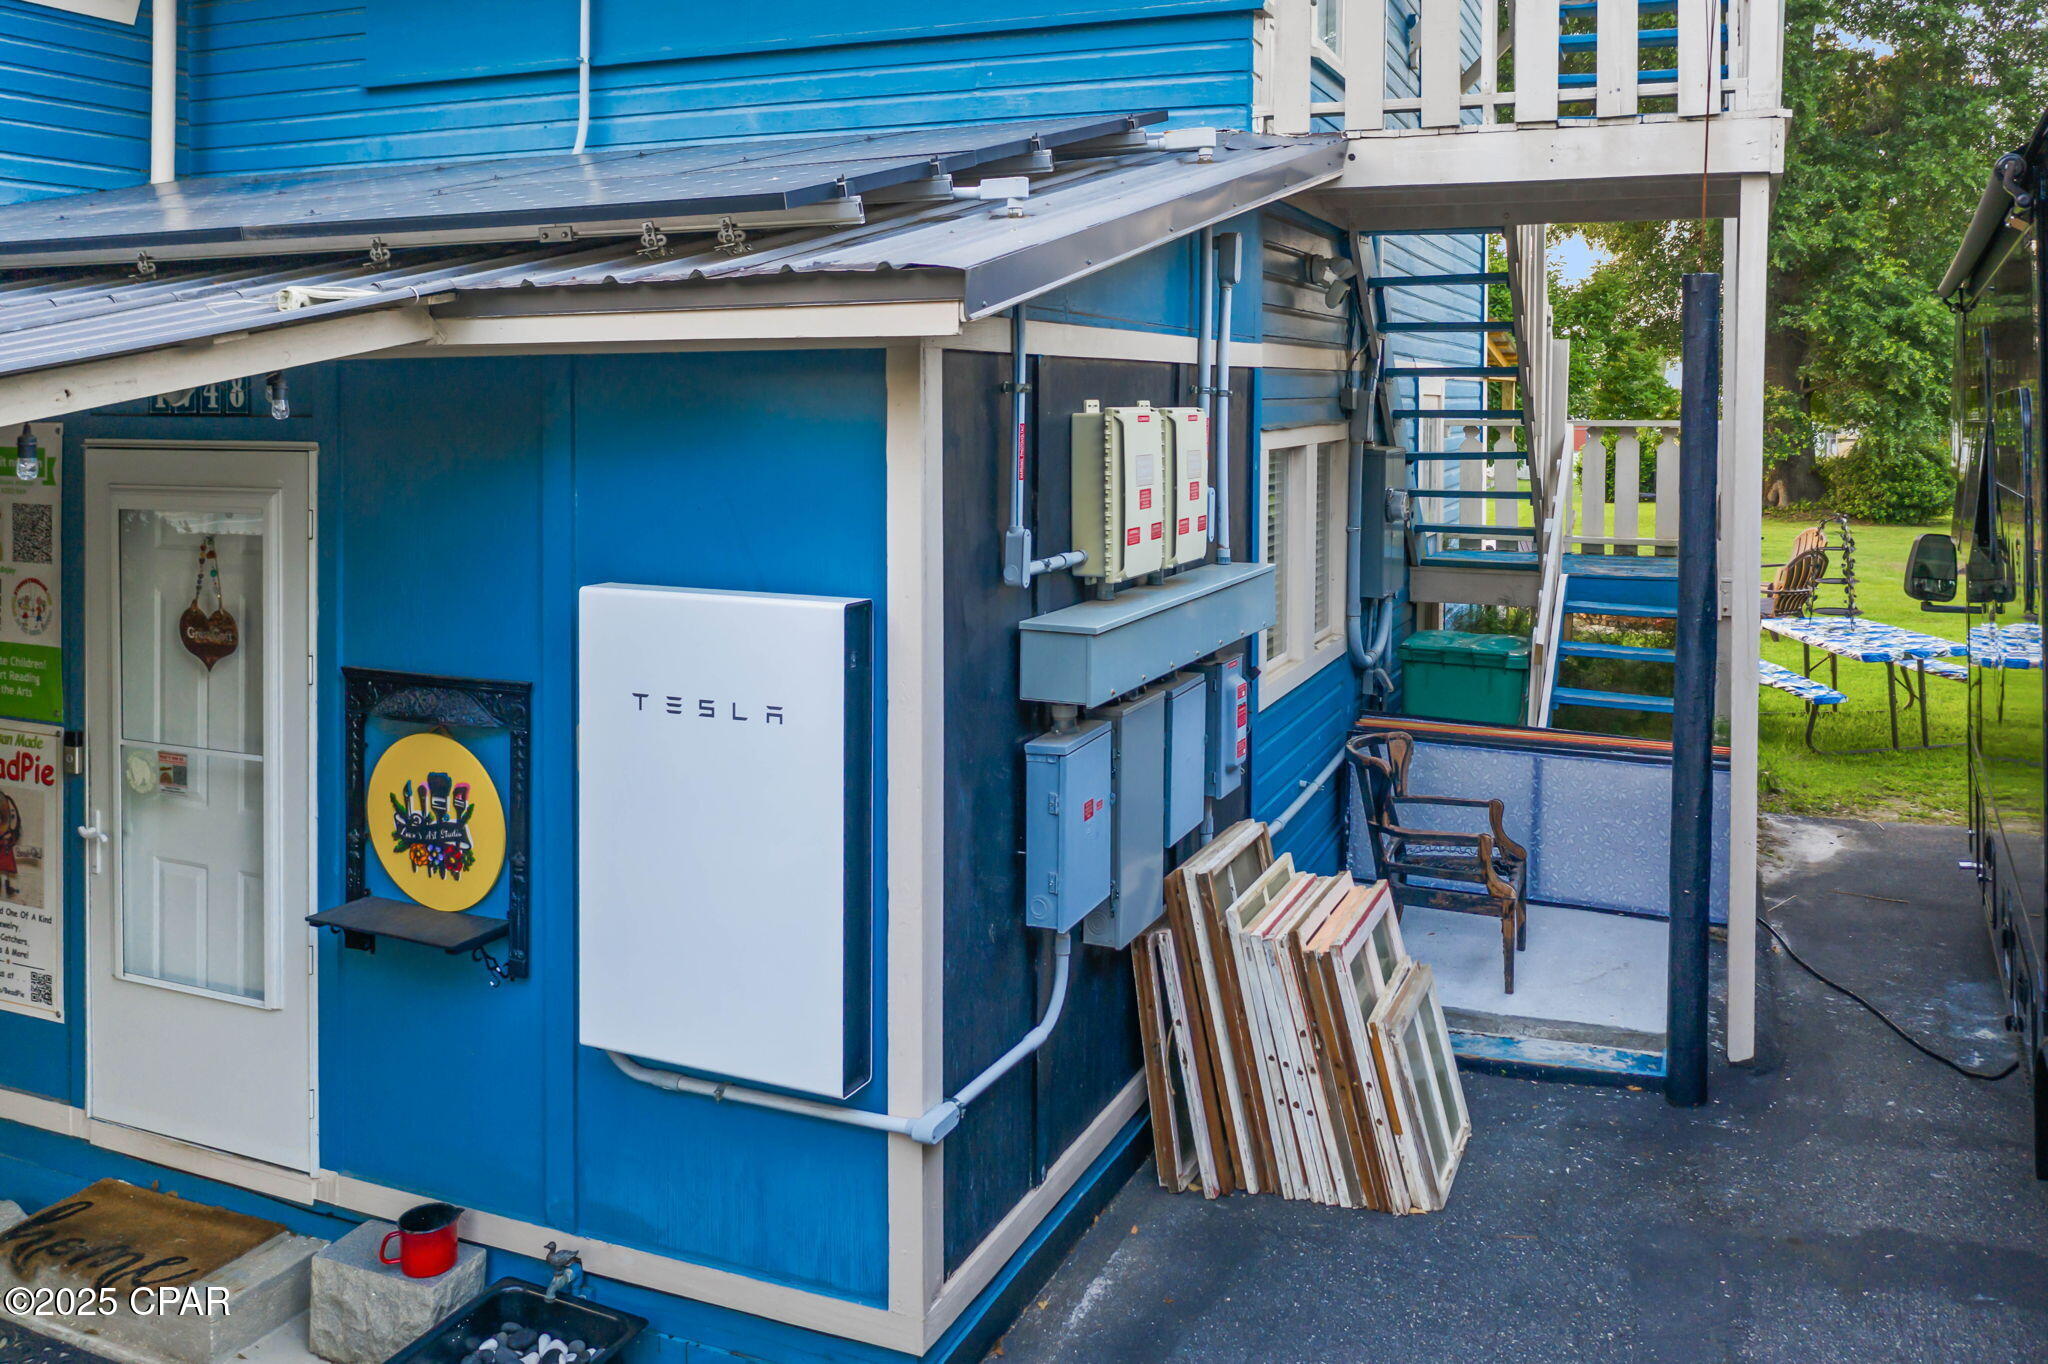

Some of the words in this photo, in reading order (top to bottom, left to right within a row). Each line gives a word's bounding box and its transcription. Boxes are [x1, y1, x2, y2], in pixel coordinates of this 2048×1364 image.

[10, 656, 47, 670] Children!
[9, 671, 41, 687] Reading
[16, 687, 32, 698] Arts
[632, 692, 783, 725] TESLA
[15, 734, 44, 749] Made
[6, 908, 18, 917] One
[20, 910, 29, 920] Of
[31, 913, 36, 921] A
[38, 914, 52, 924] Kind
